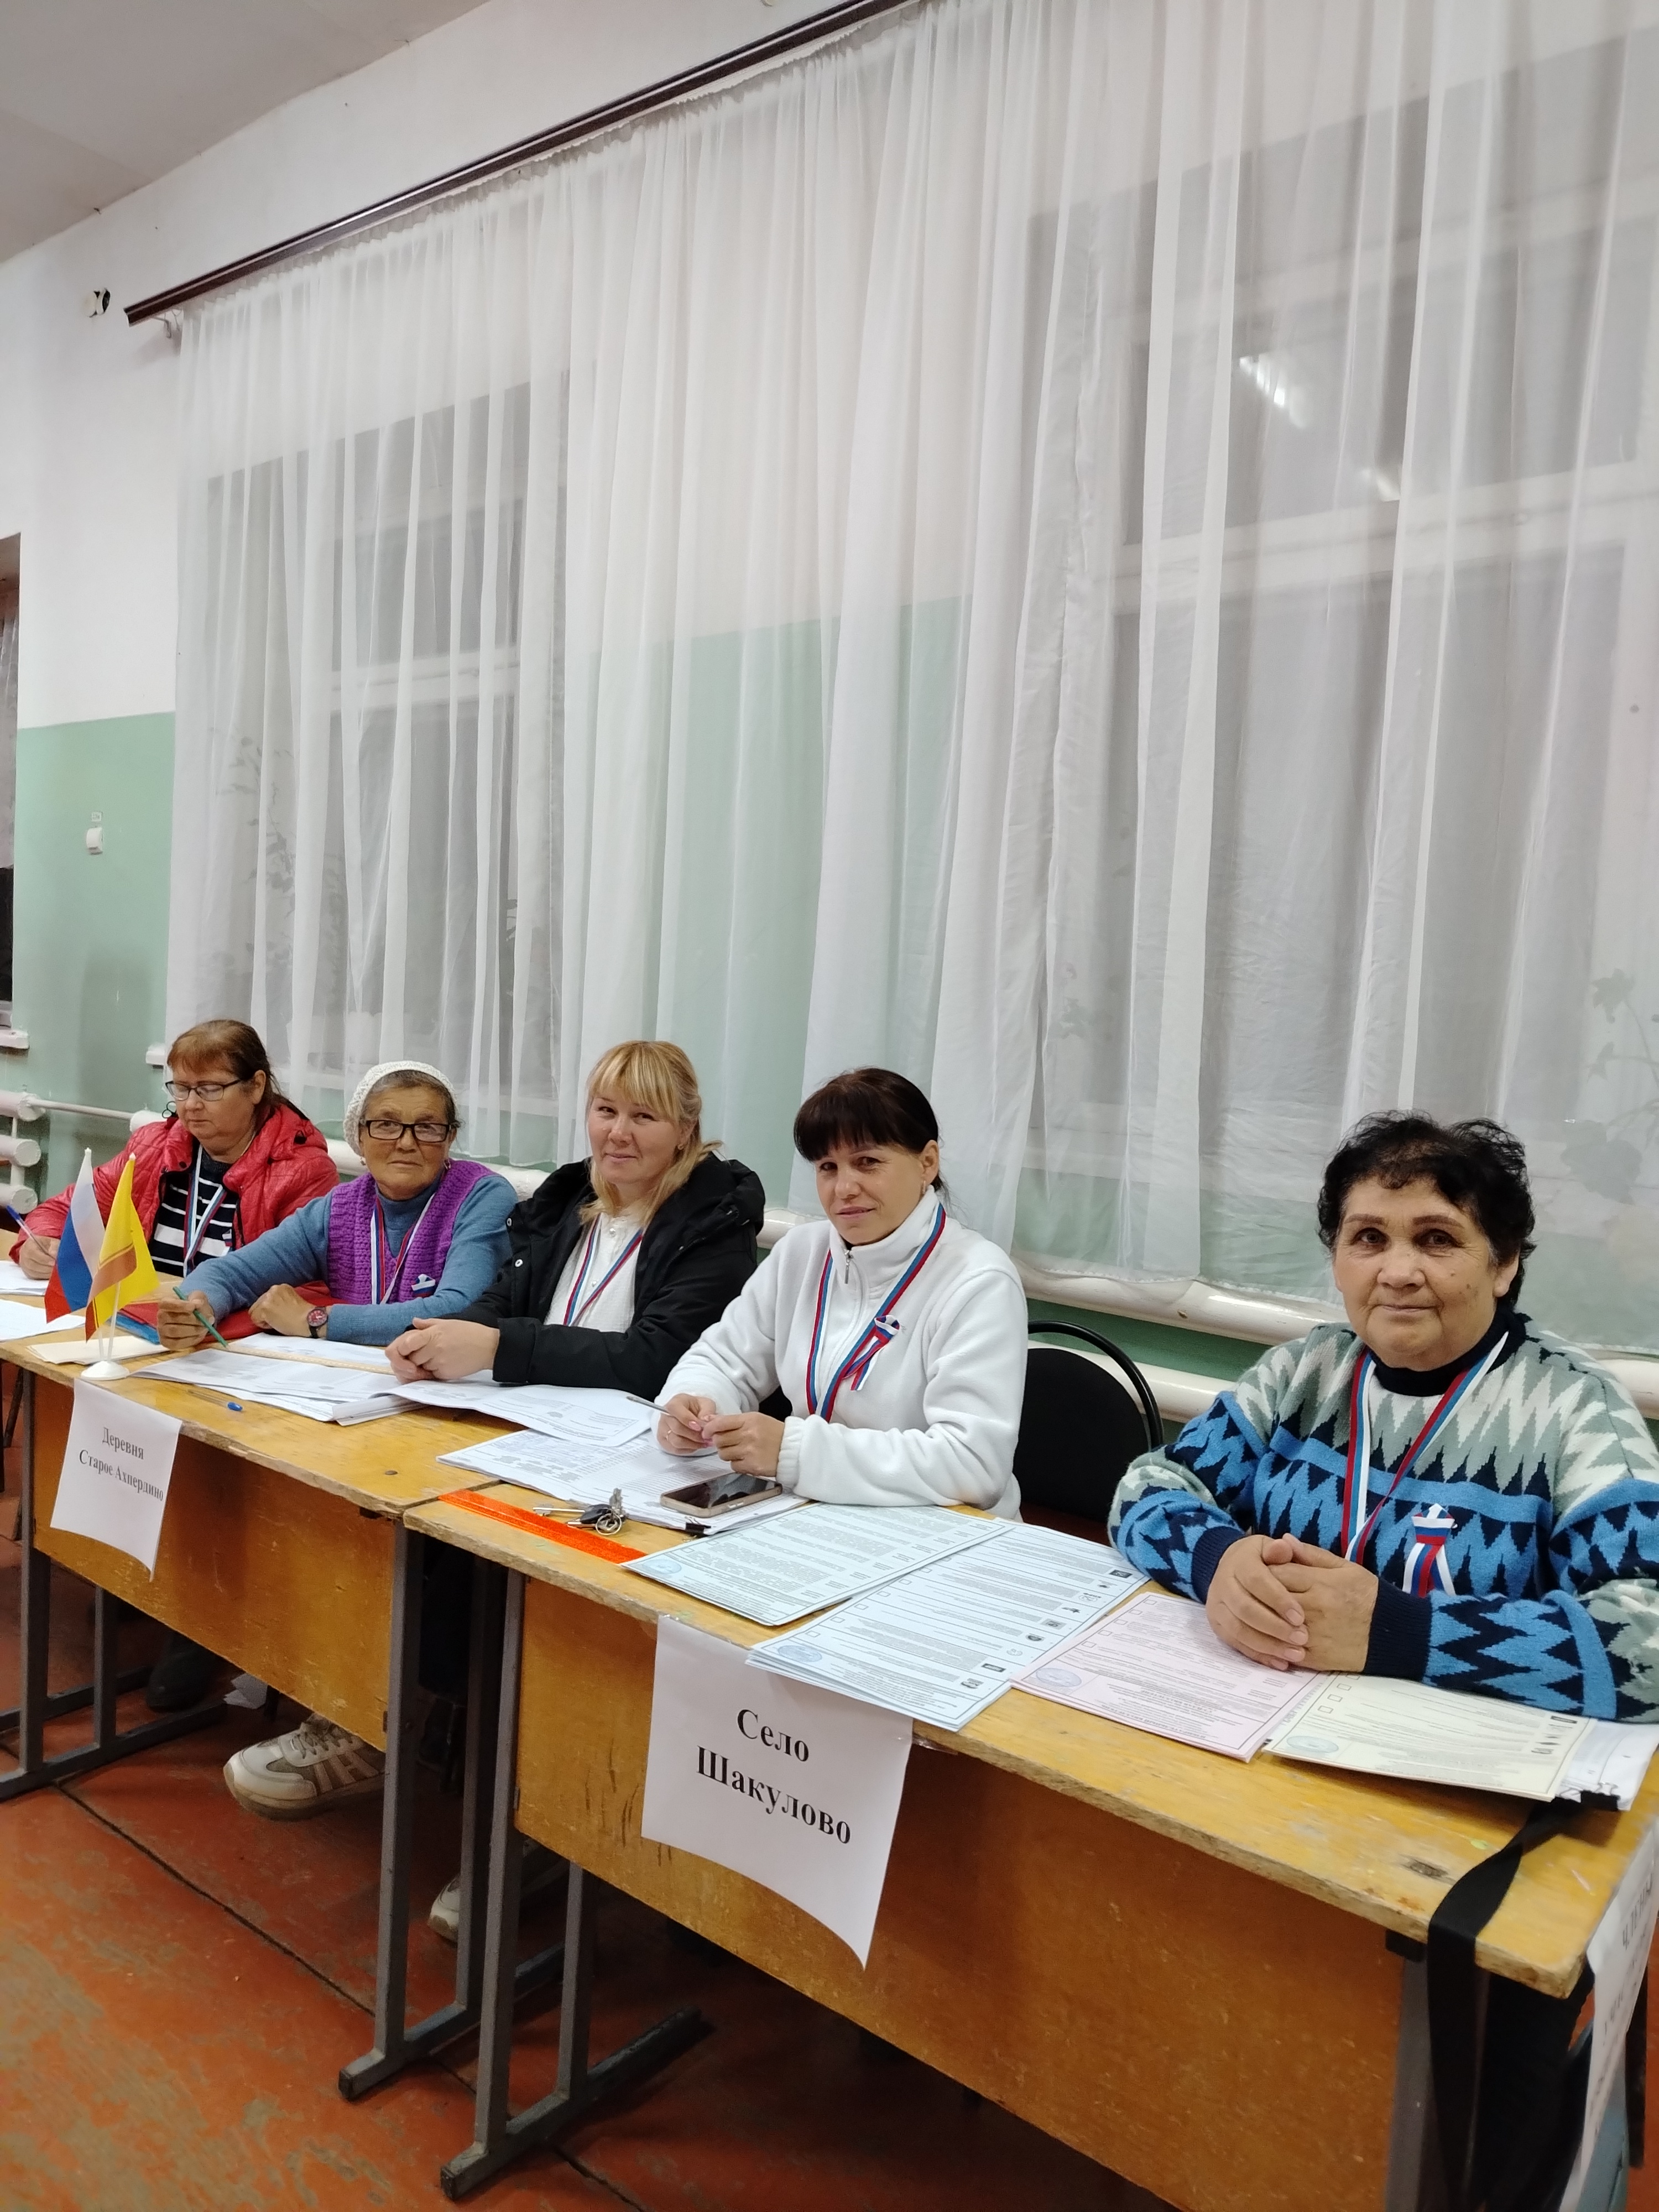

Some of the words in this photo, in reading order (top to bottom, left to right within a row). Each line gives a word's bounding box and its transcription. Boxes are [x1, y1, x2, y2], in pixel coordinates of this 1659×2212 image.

[102, 1426, 144, 1460] Деревня
[79, 1449, 113, 1475] Старое
[115, 1465, 163, 1501] Ахпердино
[737, 1709, 809, 1762] Село
[696, 1745, 851, 1845] Шакулово
